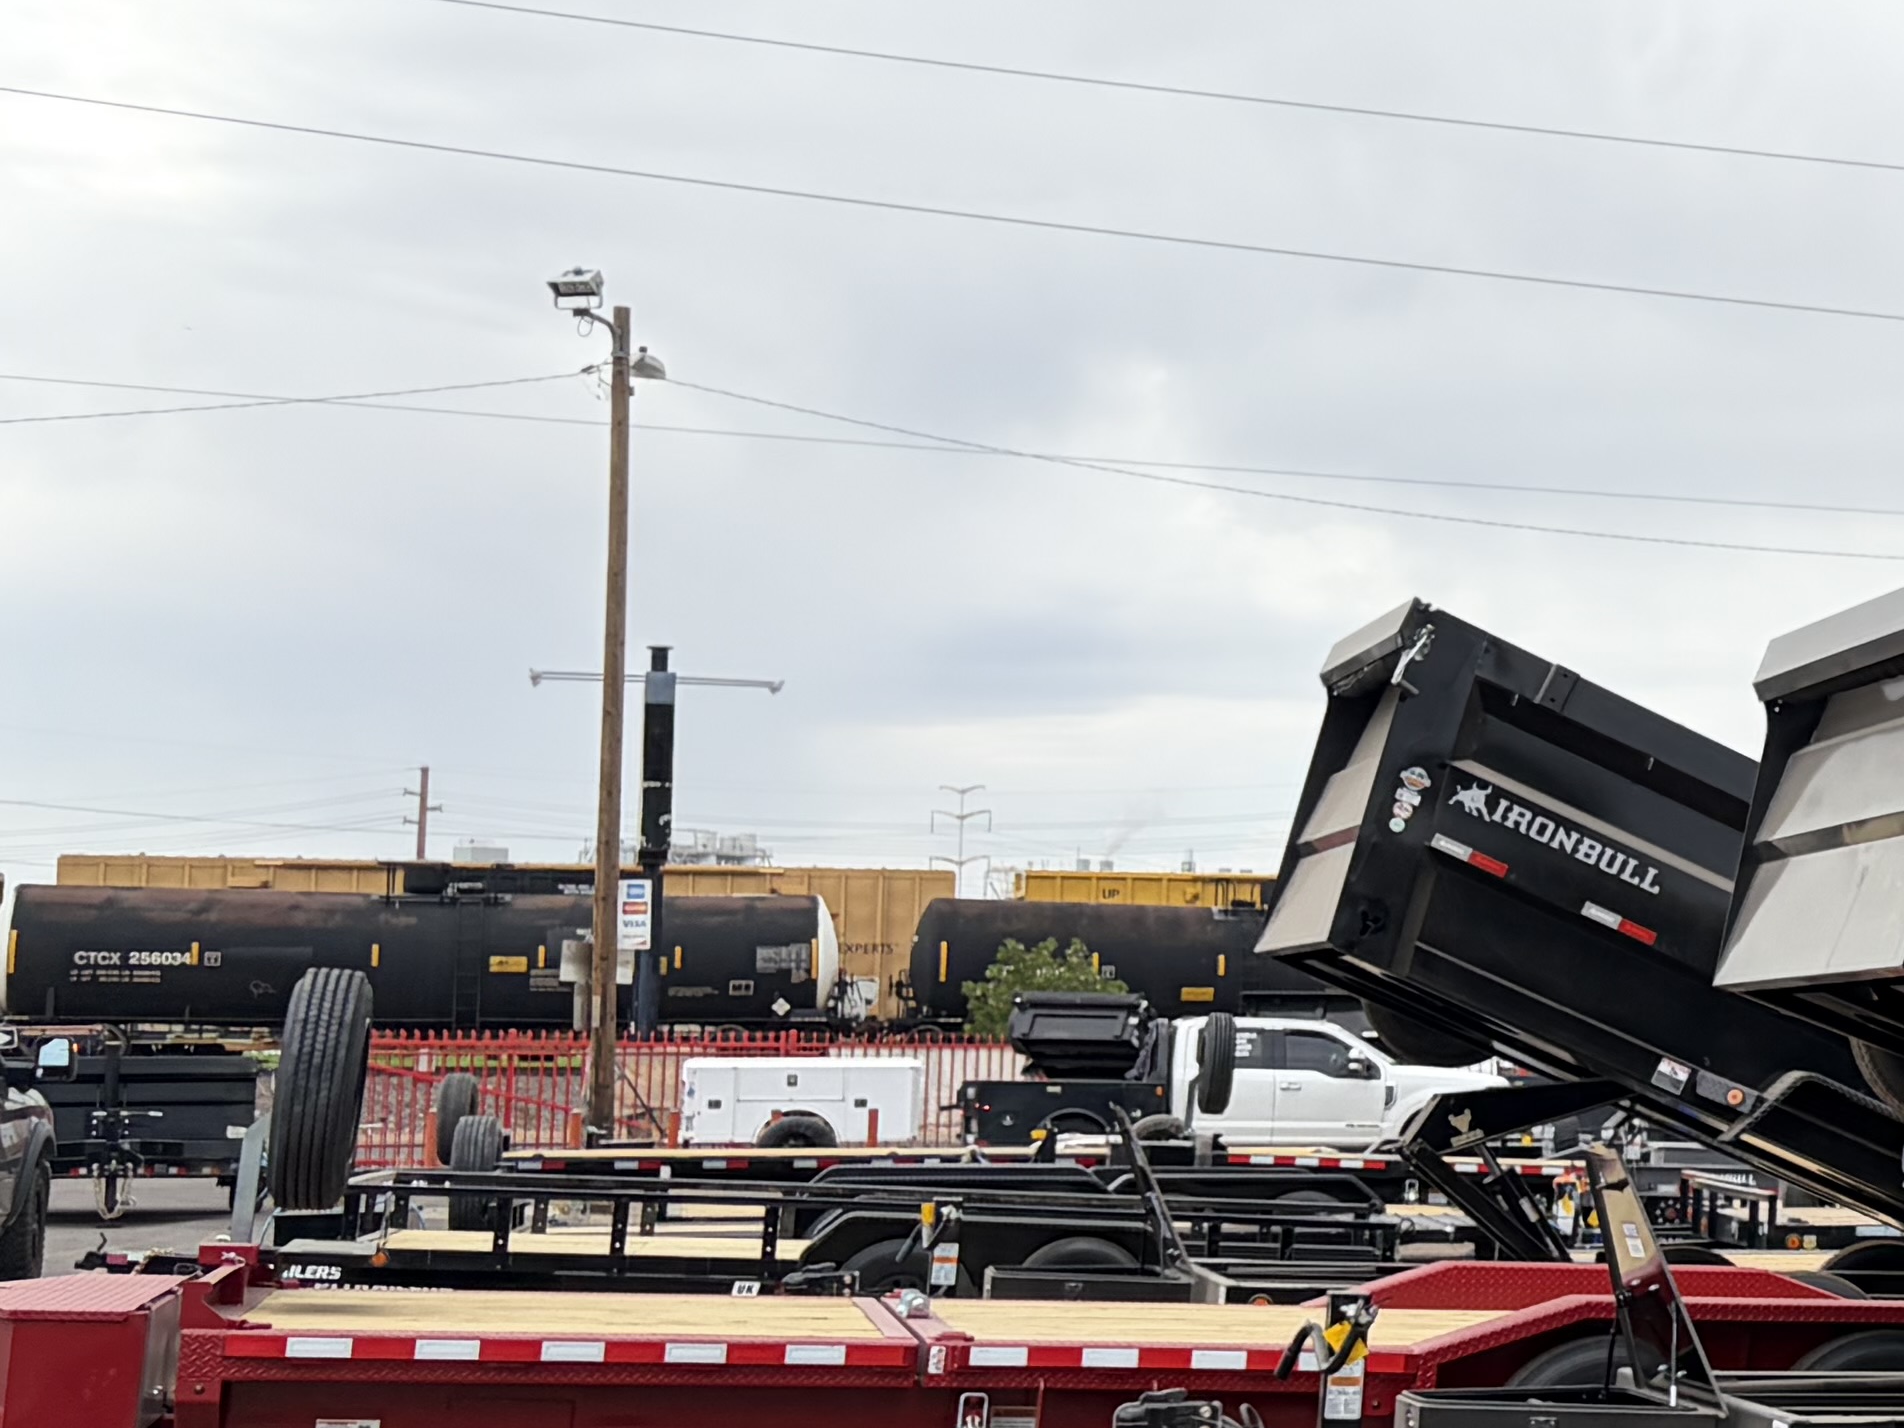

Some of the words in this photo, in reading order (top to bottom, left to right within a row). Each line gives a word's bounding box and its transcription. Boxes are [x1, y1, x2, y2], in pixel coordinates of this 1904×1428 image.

[1491, 797, 1661, 895] IRONBULL
[1102, 888, 1120, 900] UP
[622, 919, 647, 928] VISA
[73, 950, 121, 965] CTCX
[128, 950, 191, 965] 256034
[282, 1264, 342, 1280] ILERS
